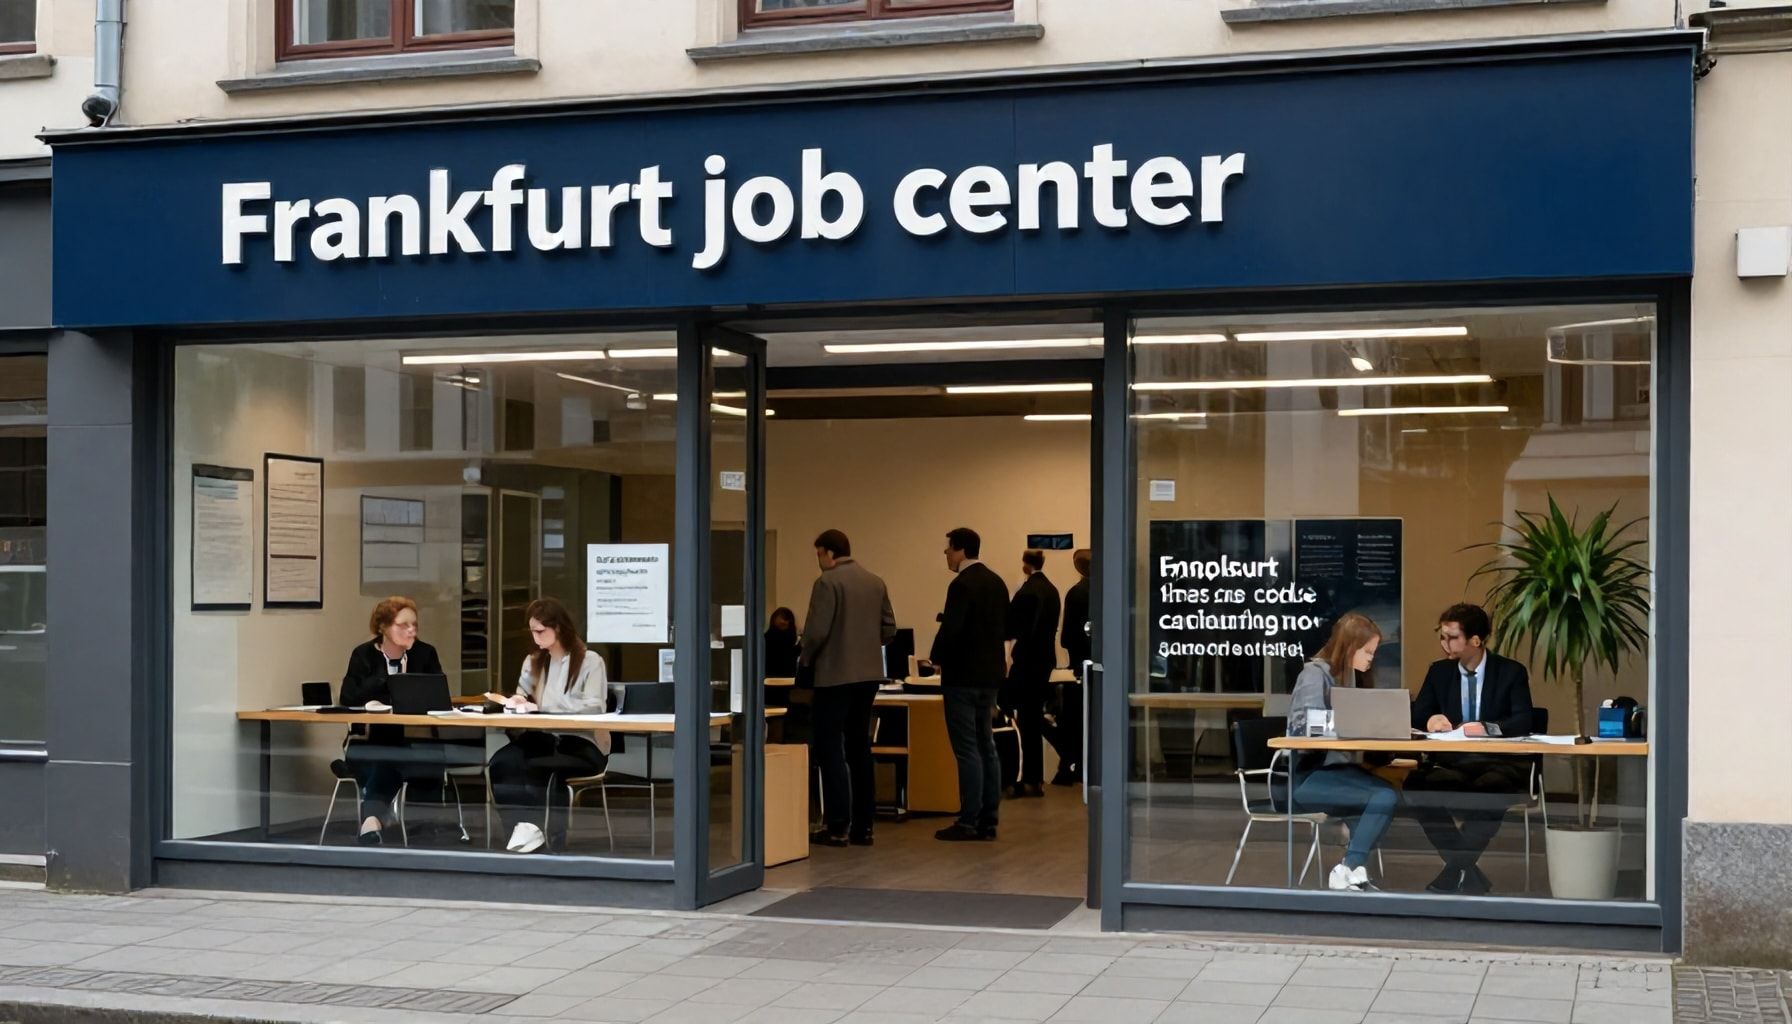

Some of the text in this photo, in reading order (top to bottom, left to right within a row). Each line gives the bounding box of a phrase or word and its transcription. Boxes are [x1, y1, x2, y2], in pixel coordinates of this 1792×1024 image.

[222, 143, 1246, 269] Frankfurt job center
